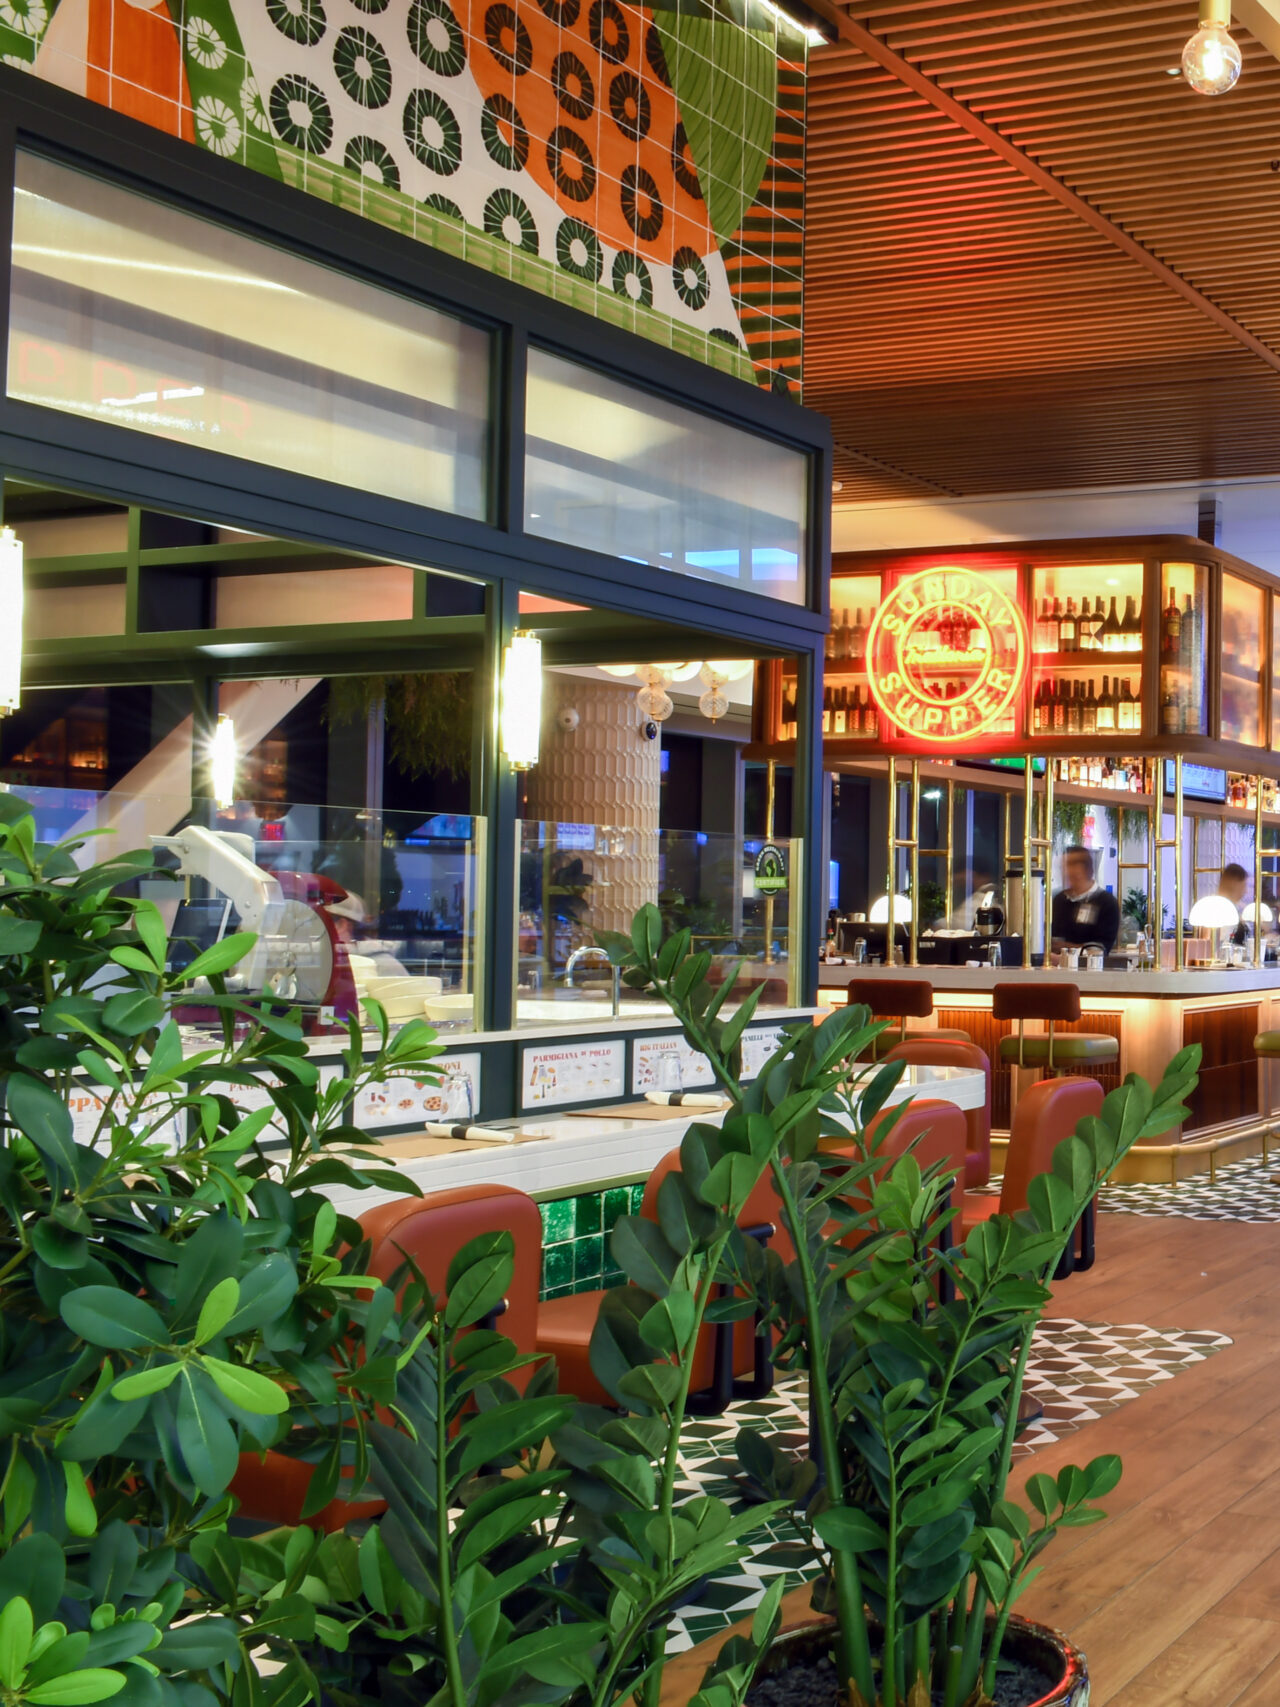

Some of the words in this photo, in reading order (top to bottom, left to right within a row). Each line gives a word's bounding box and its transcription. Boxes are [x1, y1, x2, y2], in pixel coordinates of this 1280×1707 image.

[882, 575, 1012, 637] SUNDAY
[879, 667, 1013, 731] SUPPER
[533, 1051, 578, 1063] PARMIGIANA
[589, 1048, 611, 1058] POLLO
[652, 1041, 677, 1051] ITALIAN
